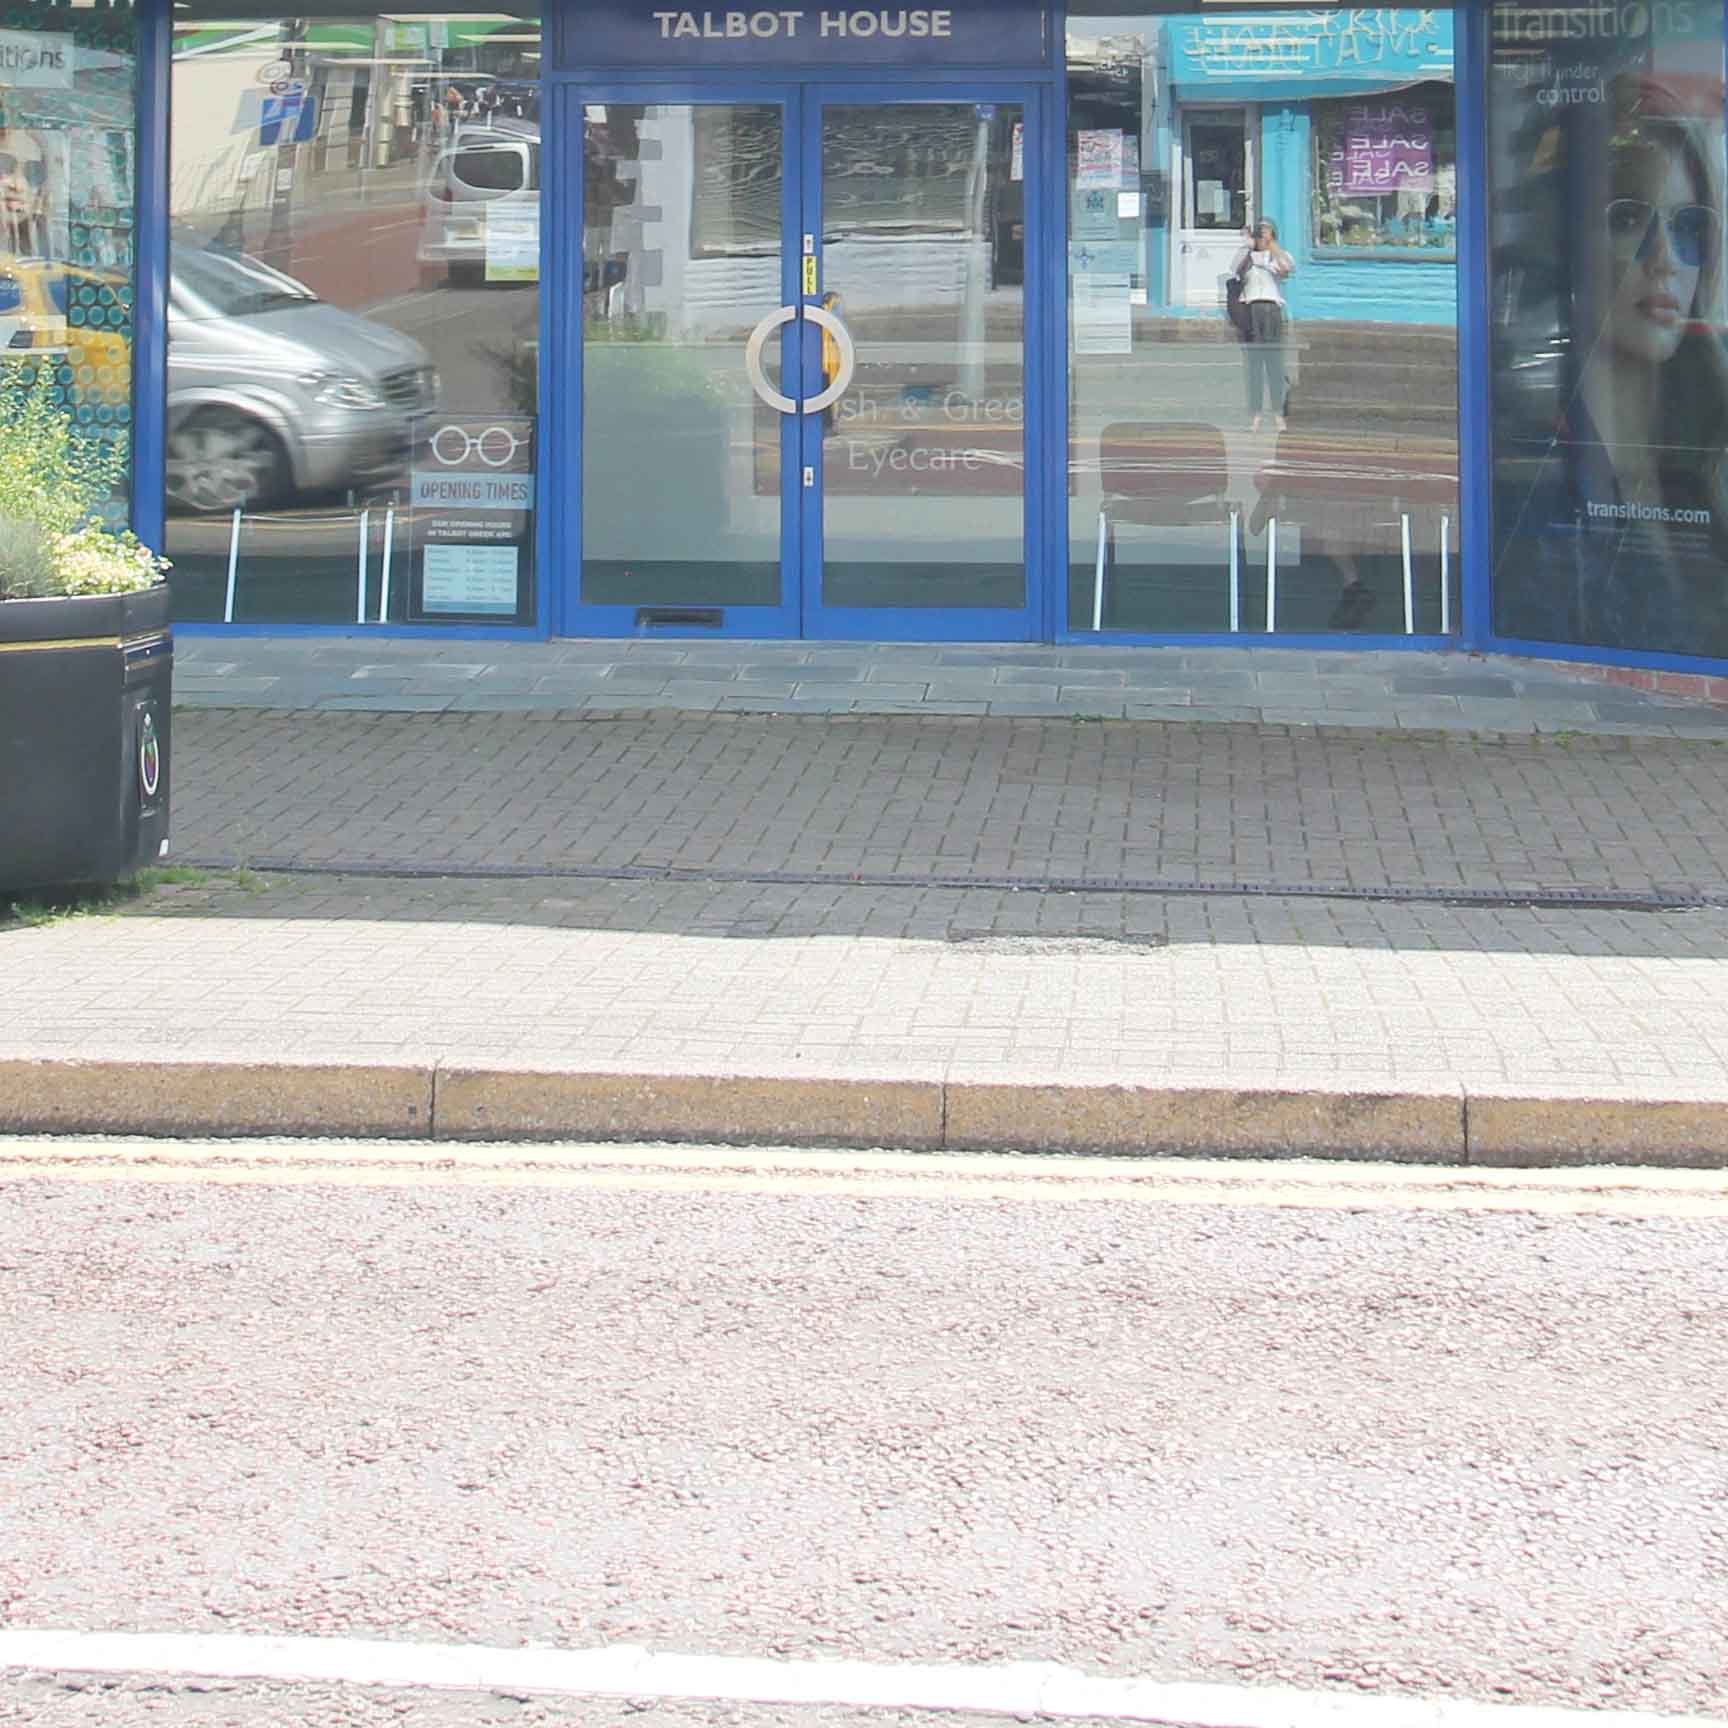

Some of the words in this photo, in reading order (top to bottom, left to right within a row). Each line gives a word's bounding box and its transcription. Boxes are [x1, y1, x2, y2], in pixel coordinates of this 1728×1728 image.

[653, 10, 804, 39] TALBOT
[819, 10, 952, 39] HOUSE
[1494, 0, 1693, 39] Transitions
[1536, 80, 1605, 105] control
[945, 390, 1023, 422] Gree
[848, 440, 982, 478] Eyecare
[421, 479, 481, 500] OPENING
[486, 482, 528, 501] TIMES
[1587, 500, 1711, 523] transitions.com
